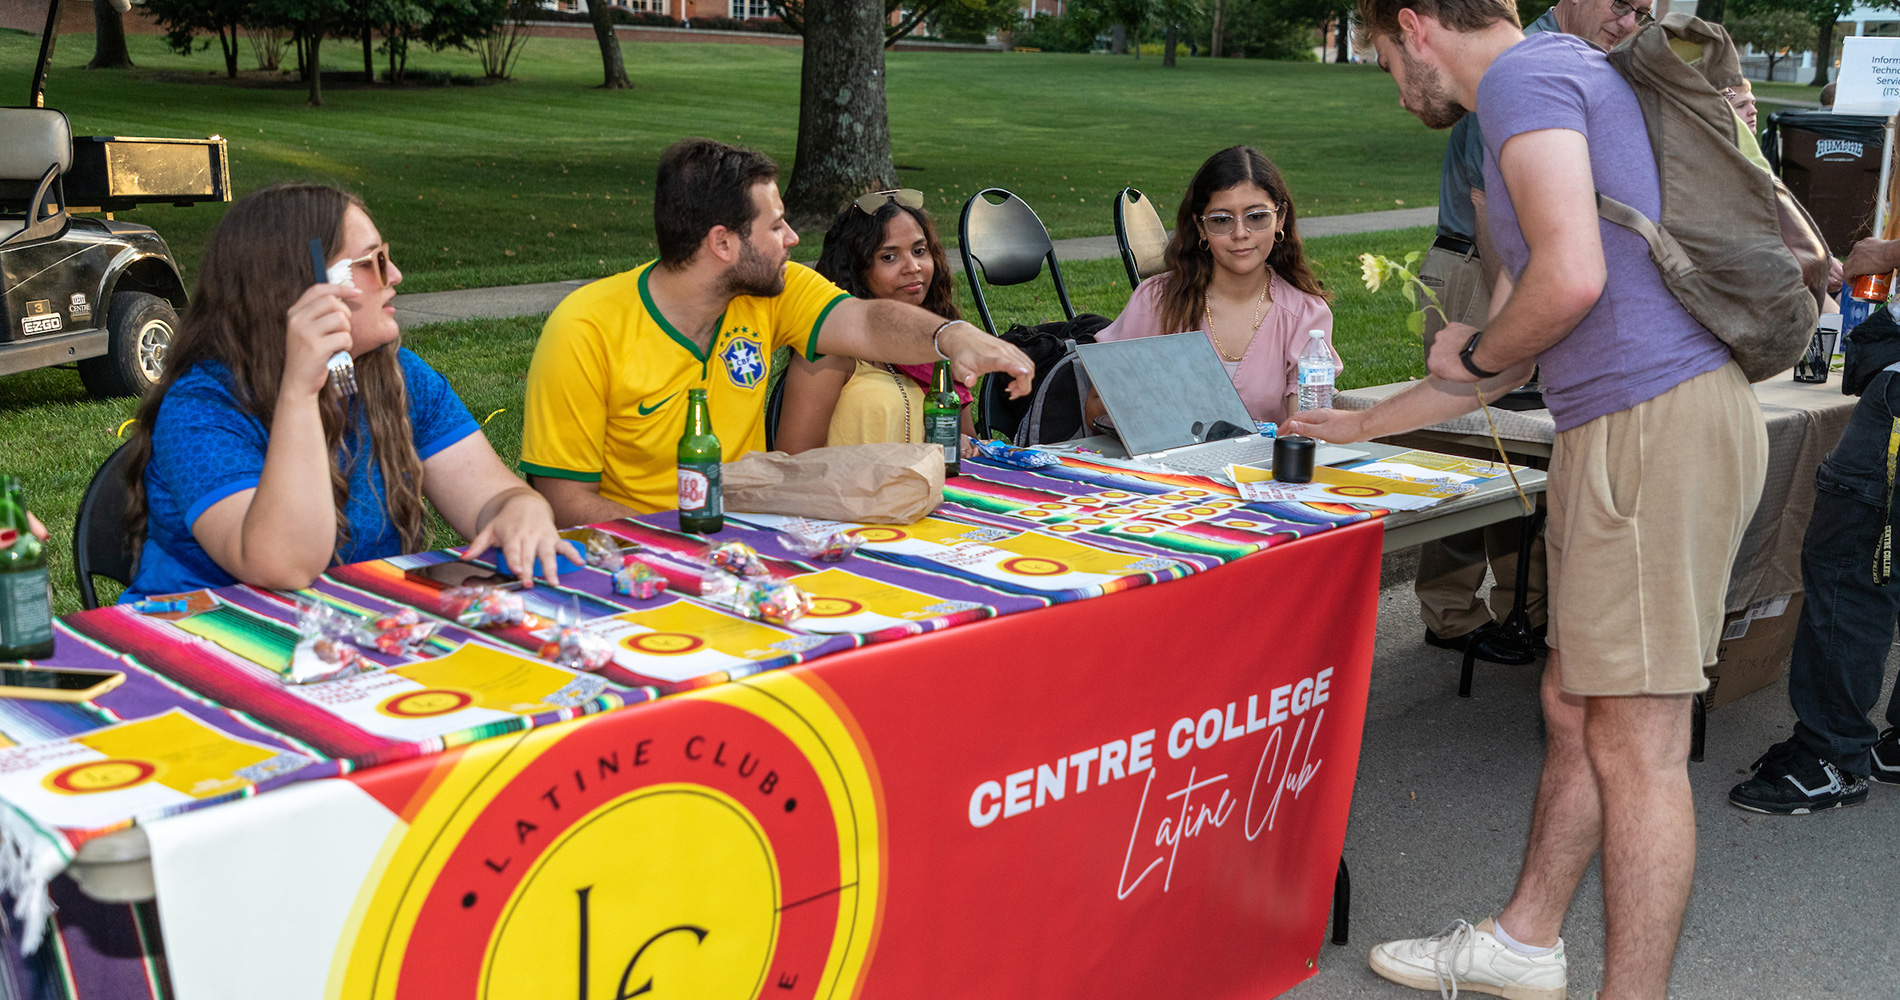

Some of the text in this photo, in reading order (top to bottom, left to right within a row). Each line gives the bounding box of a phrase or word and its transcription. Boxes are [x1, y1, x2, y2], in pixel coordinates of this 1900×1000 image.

[1883, 87, 1900, 97] (ITS
[34, 303, 43, 313] 3
[736, 356, 751, 367] CBF
[1883, 525, 1892, 577] CENTRE COLLEGE
[968, 666, 1334, 828] CENTRE COLLEGE
[484, 735, 779, 875] LATINE CLUB
[1117, 708, 1324, 900] Latine Club
